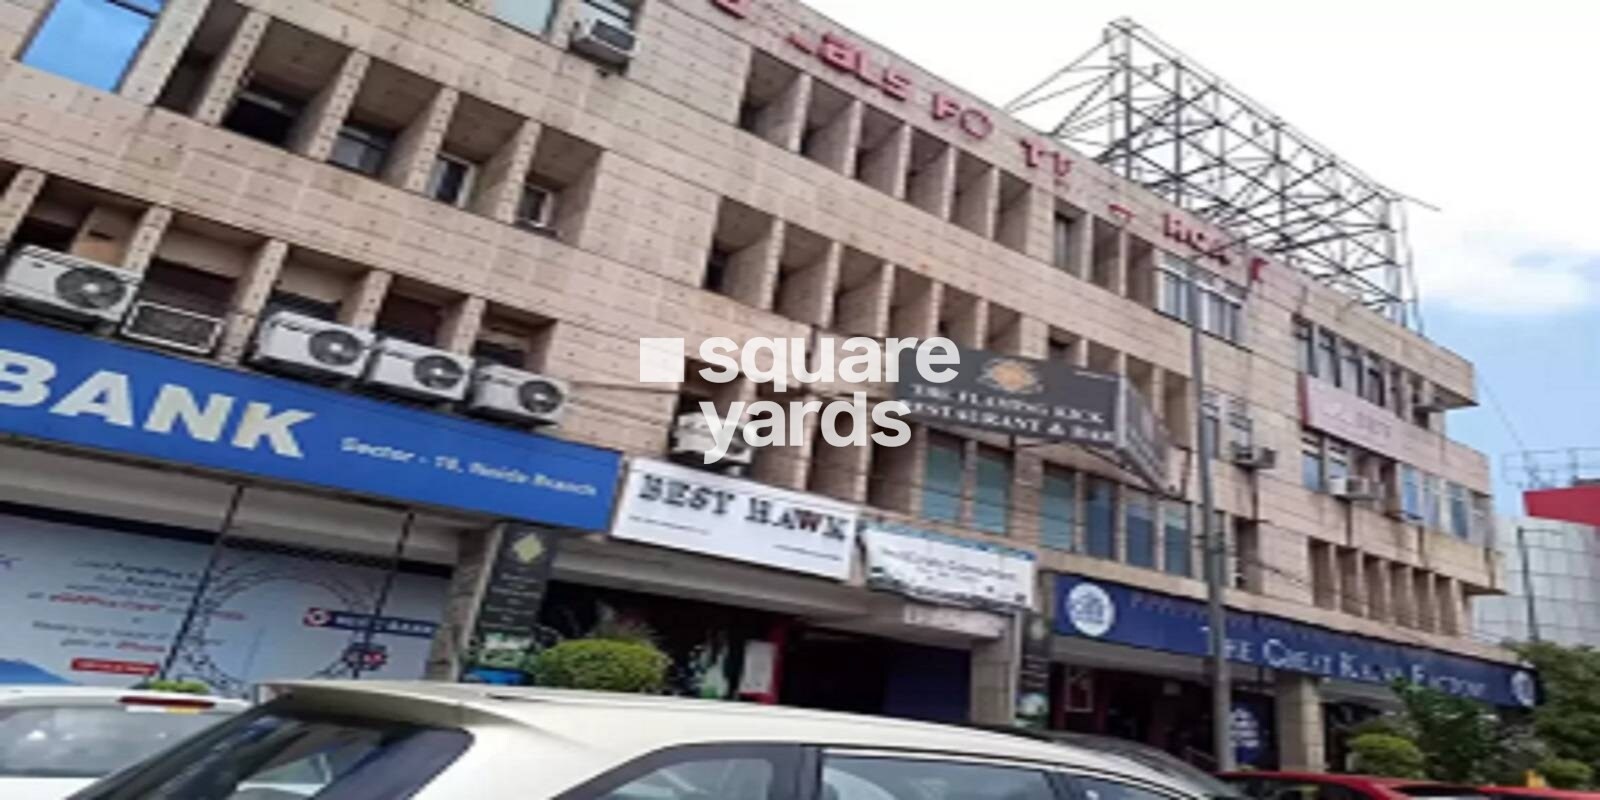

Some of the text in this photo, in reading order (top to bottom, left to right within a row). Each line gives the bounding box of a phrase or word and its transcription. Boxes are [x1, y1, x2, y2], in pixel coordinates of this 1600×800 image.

[0, 348, 315, 459] BANK
[340, 436, 415, 463] Sector
[639, 473, 734, 515] BEST
[743, 497, 850, 543] HAWK
